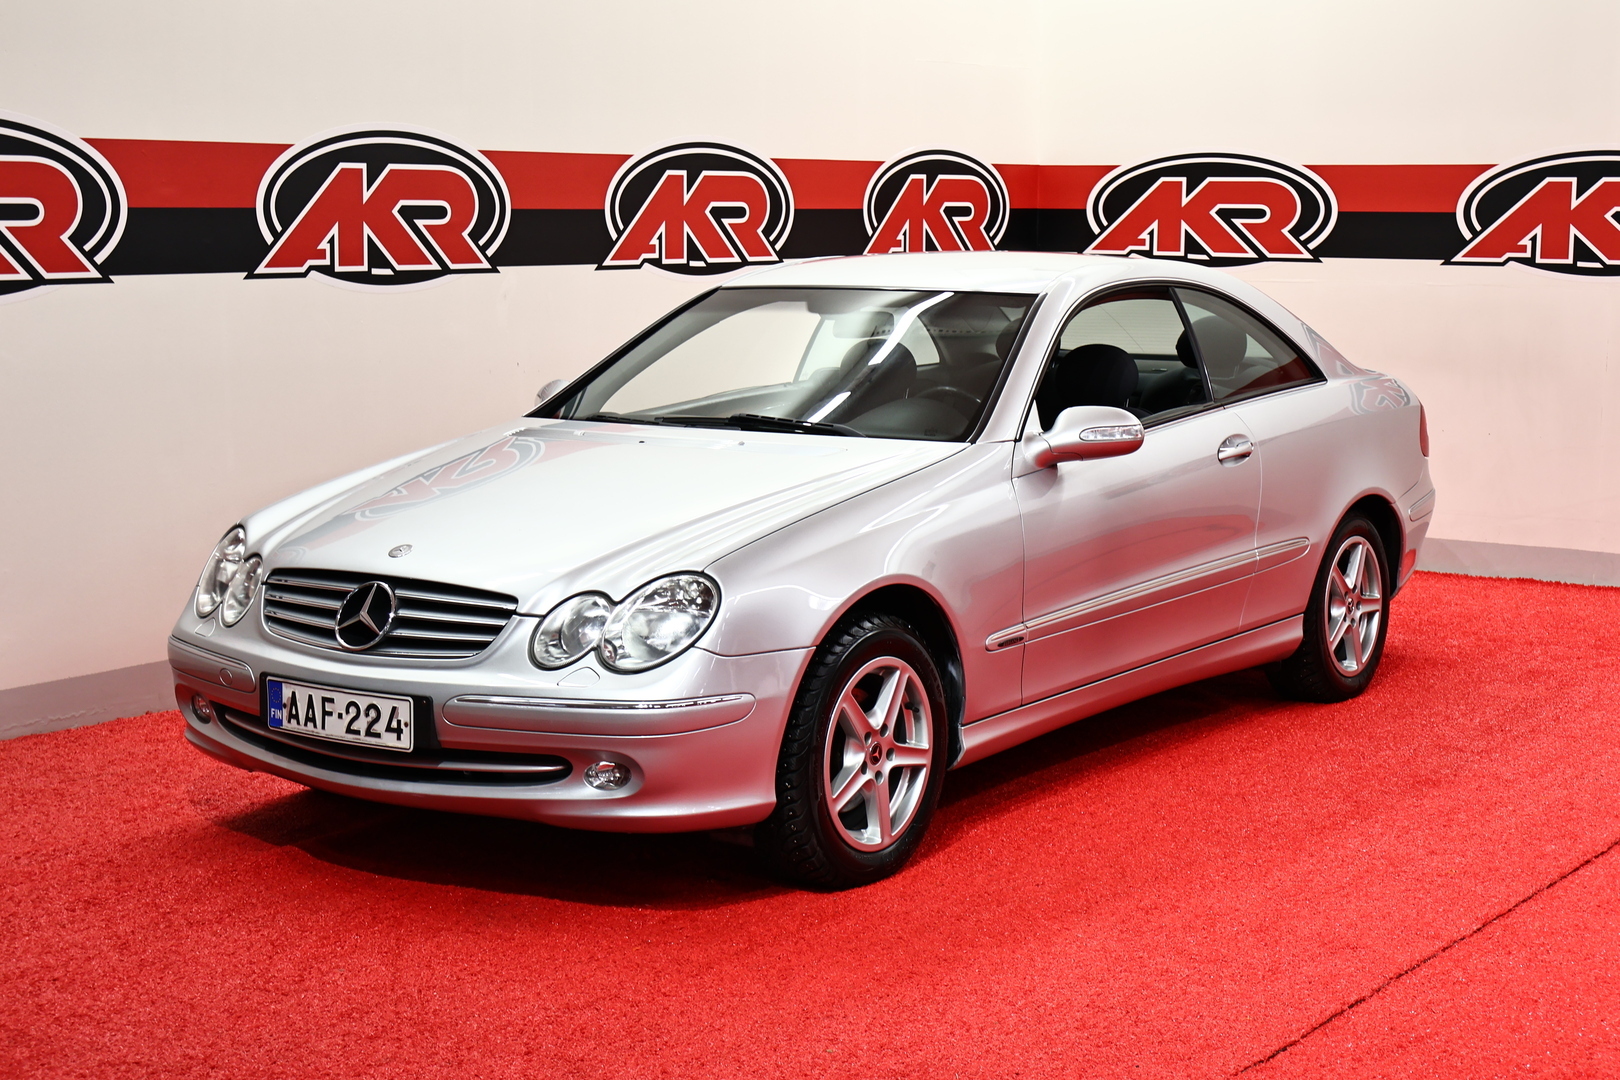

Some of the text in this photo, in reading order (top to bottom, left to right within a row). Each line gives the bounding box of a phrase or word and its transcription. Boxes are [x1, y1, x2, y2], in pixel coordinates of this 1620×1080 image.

[254, 162, 492, 273] AKR
[602, 170, 780, 266] AKR
[863, 174, 996, 253] AKR
[1083, 177, 1314, 259] AKR
[1451, 177, 1620, 264] AK
[270, 708, 282, 720] FIN
[287, 690, 404, 741] AAF-224
